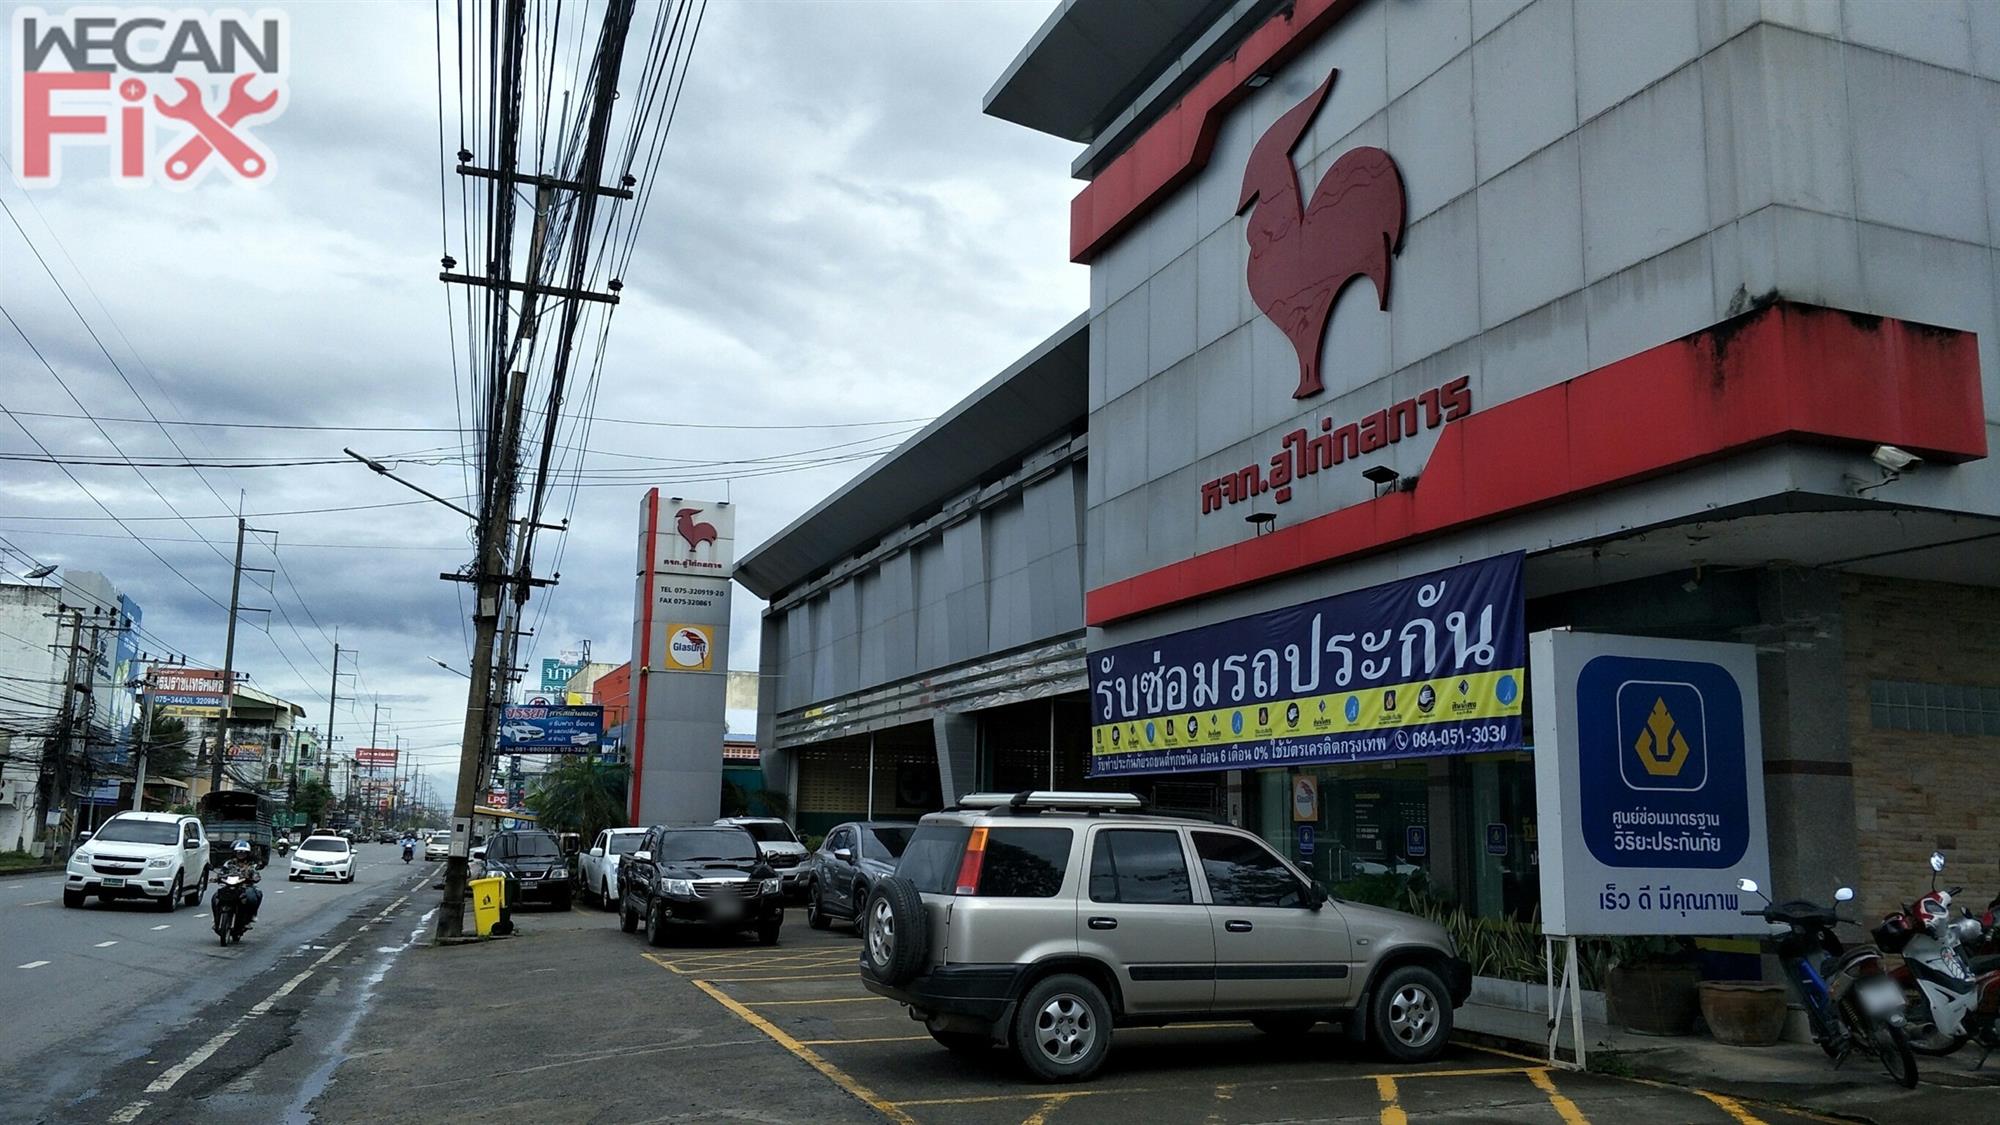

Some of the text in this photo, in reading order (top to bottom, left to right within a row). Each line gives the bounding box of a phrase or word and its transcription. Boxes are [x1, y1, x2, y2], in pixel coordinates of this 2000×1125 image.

[1096, 580, 1495, 720] รับซ่อมรถประกัน
[1200, 748, 1219, 765] ผ่อน
[1220, 750, 1226, 763] 6
[1228, 745, 1252, 762] เดือน
[1253, 746, 1269, 760] 0%
[1412, 725, 1507, 748] 084-051-3030
[487, 796, 507, 804] LPG
[1612, 806, 1720, 829] ศูนย์ซ่อมมาตรฐาน
[1614, 831, 1721, 852] วิริยะประกันภัย
[1599, 883, 1739, 918] เร็ว ดี มีคุณภาพ
